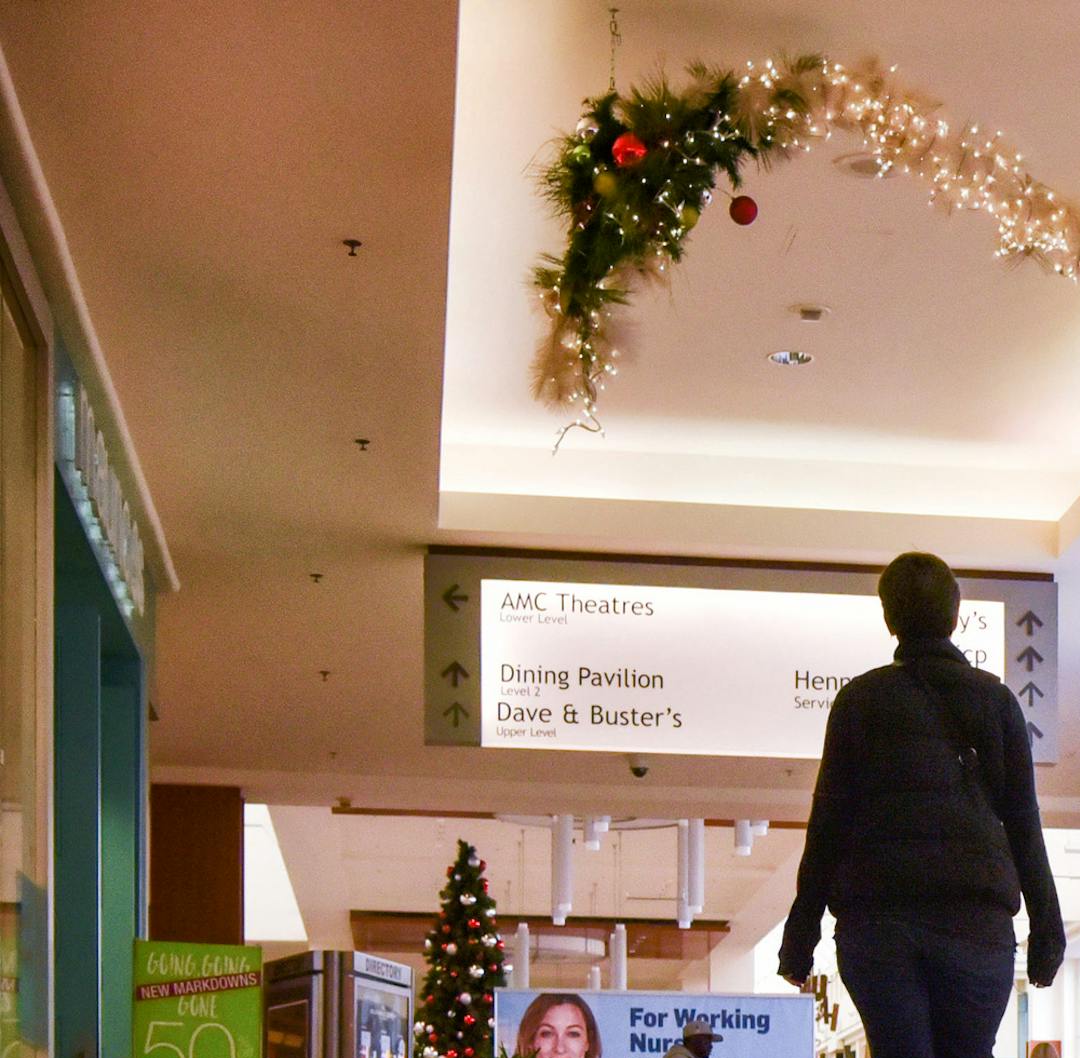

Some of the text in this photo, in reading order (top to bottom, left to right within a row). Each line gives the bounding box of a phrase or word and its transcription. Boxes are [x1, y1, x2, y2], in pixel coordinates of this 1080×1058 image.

[501, 592, 655, 617] AMC Theatres
[499, 612, 568, 625] Lower Level
[959, 611, 988, 633] y's
[501, 664, 665, 690] Dining Pavilion
[795, 670, 852, 691] Henn
[500, 686, 541, 697] Level 2
[794, 696, 833, 709] Servi
[497, 702, 682, 728] Dave & Buster's
[496, 727, 557, 738] Upper Level
[365, 958, 401, 979] DIRECTORY
[141, 972, 258, 999] NEW MARKDOWNS
[178, 995, 218, 1019] GONE
[630, 1008, 770, 1034] For Working
